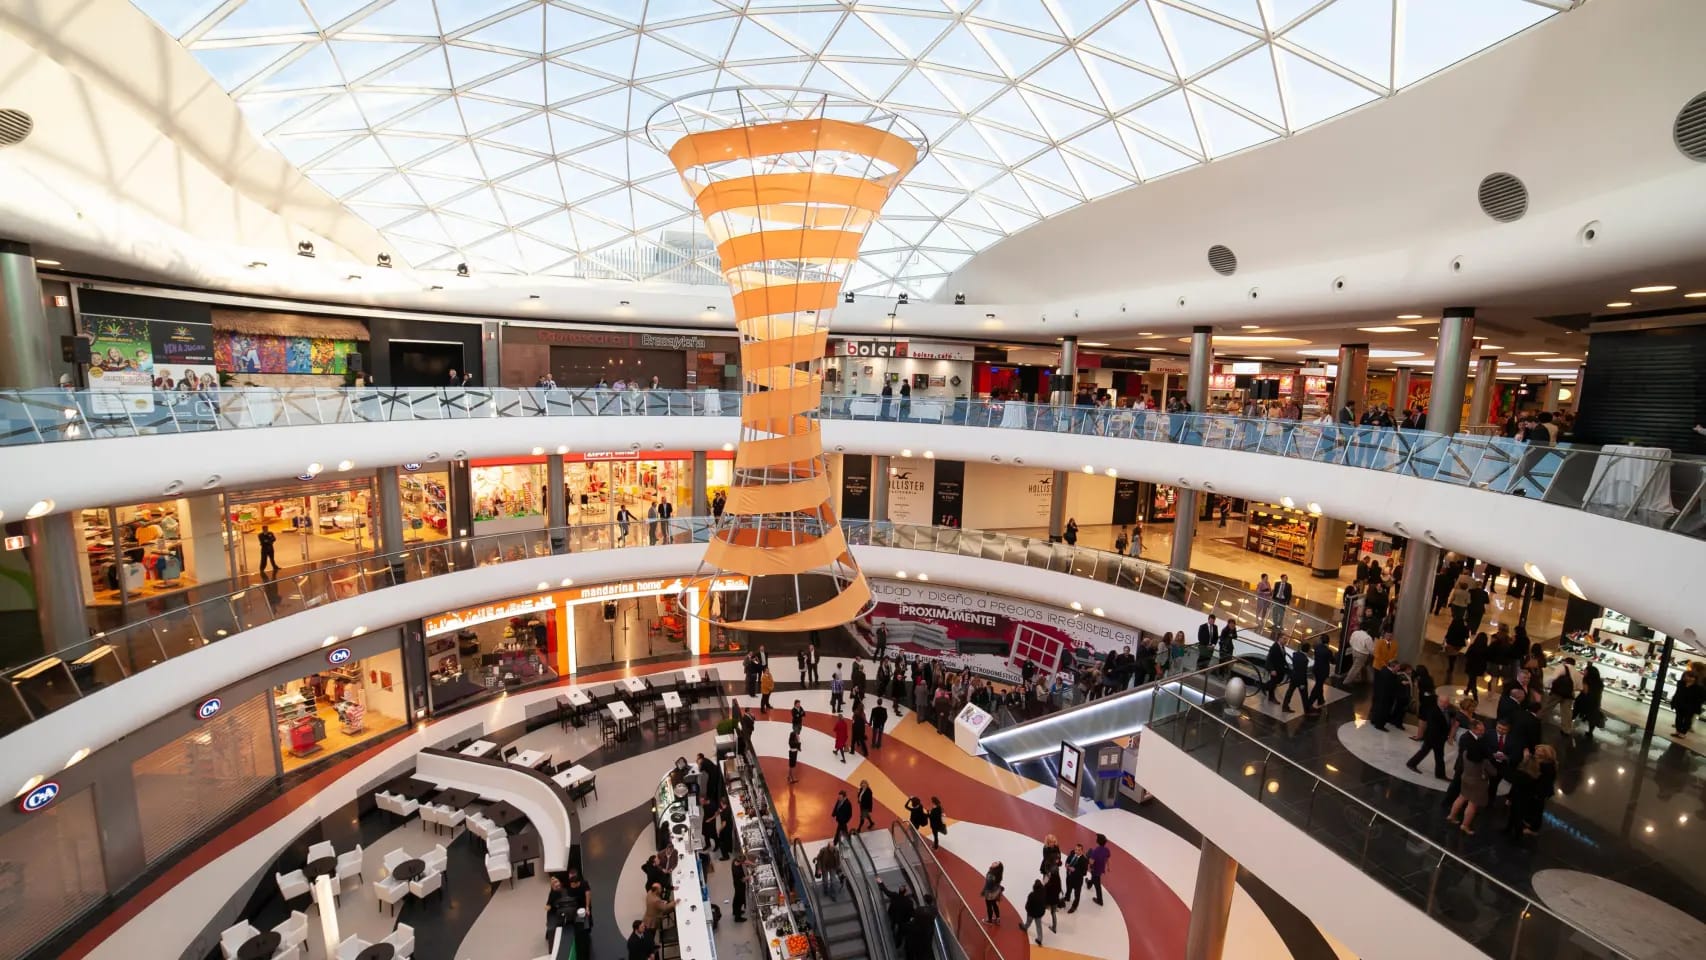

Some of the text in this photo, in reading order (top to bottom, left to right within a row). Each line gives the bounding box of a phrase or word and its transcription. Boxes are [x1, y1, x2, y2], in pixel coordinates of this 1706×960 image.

[580, 580, 662, 599] mandarina home
[899, 606, 996, 627] ¡PROXIMAMENTE!
